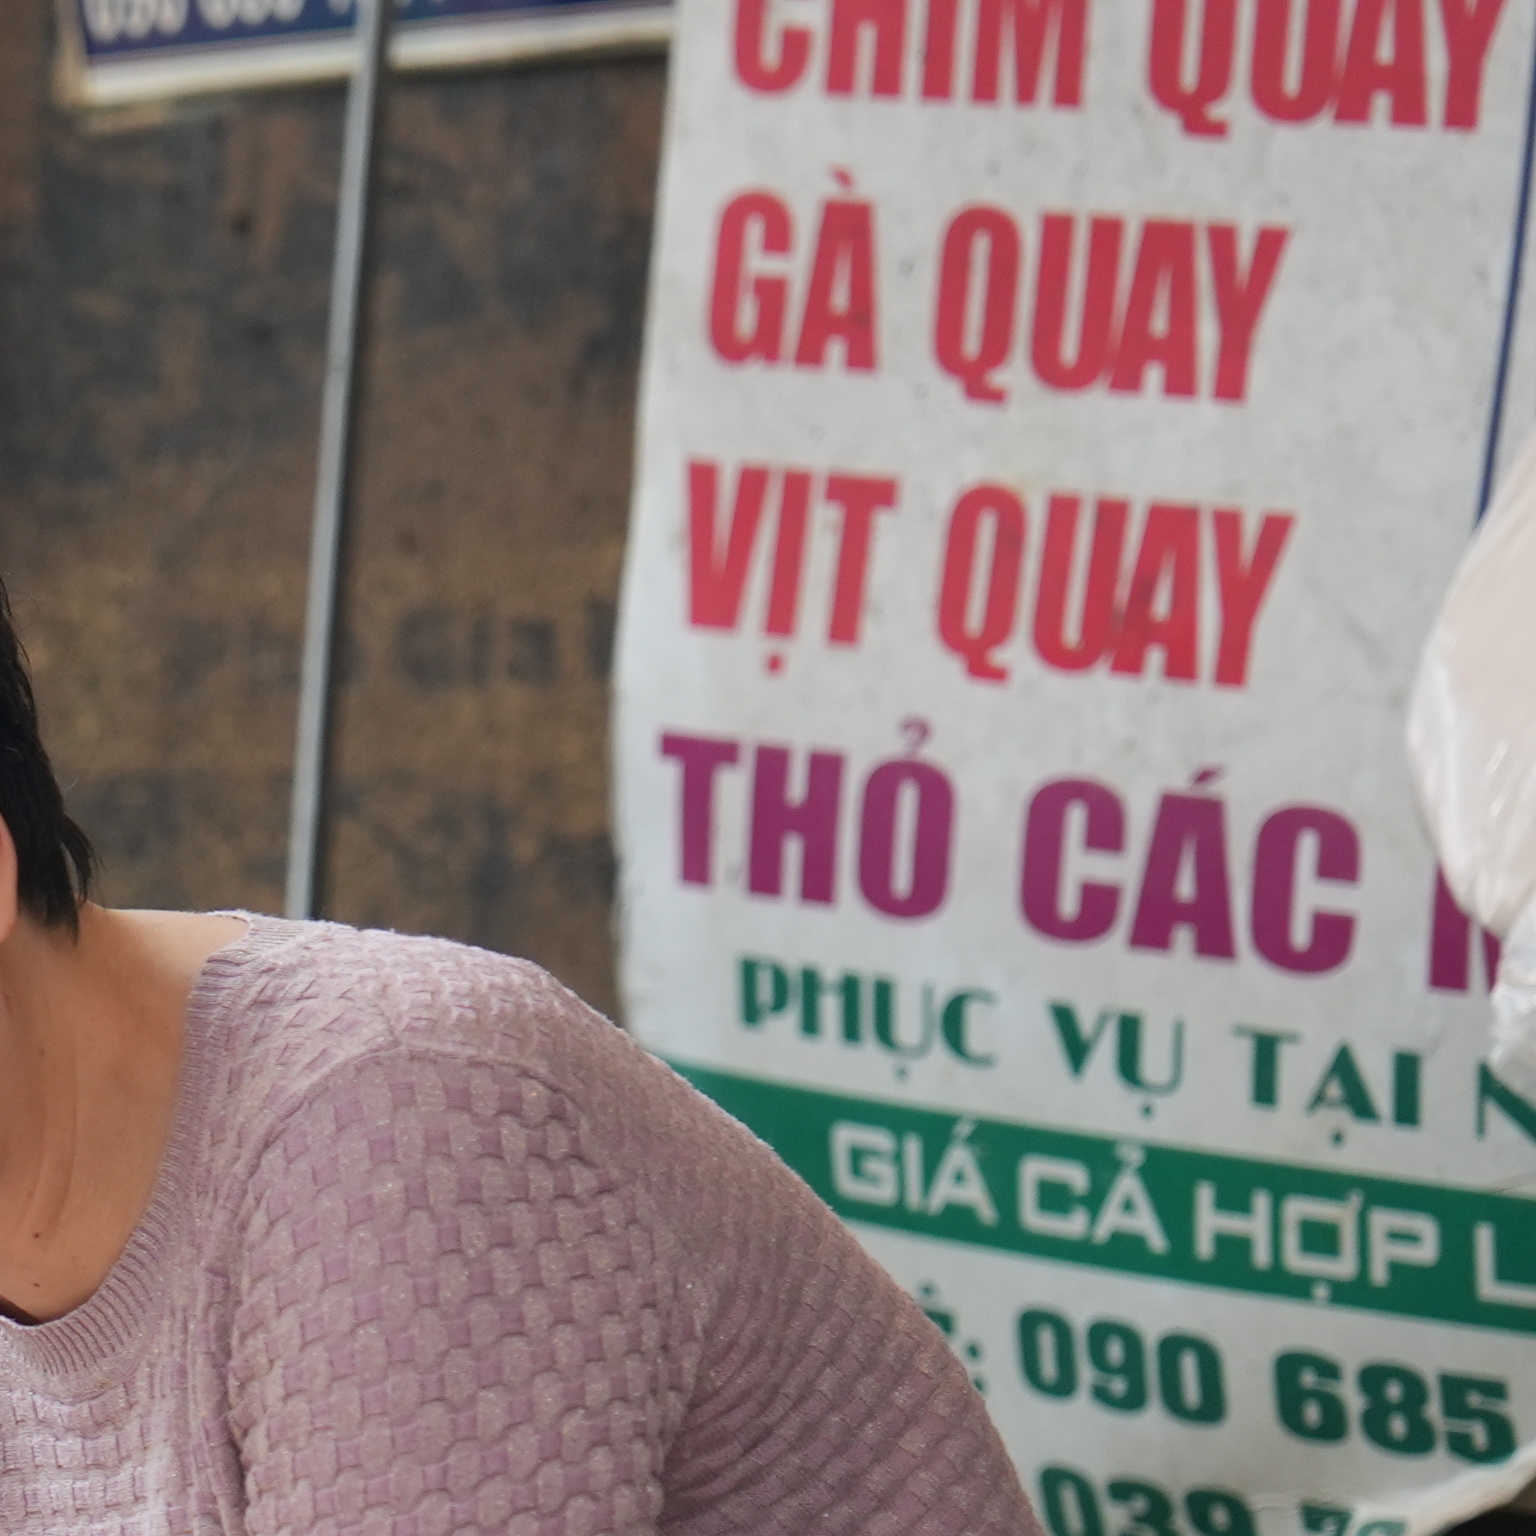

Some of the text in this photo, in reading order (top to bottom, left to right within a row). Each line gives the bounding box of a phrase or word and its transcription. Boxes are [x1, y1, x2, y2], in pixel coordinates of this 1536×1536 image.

[1146, 0, 1505, 139] QUAY
[706, 166, 1291, 406] GÀ QUAY
[684, 457, 1296, 689] VỊT QUAY
[659, 717, 957, 921] THỎ
[1020, 765, 1361, 974] CÁC
[738, 955, 999, 1081] PHỤC
[1046, 1000, 1188, 1119] VỤ
[1232, 1022, 1422, 1148] TẠI
[828, 1117, 1000, 1225] GIÁ
[1019, 1143, 1169, 1252] CẢ
[1195, 1179, 1443, 1305] HỢP
[1015, 1308, 1226, 1426] 090
[1272, 1351, 1517, 1468] 685
